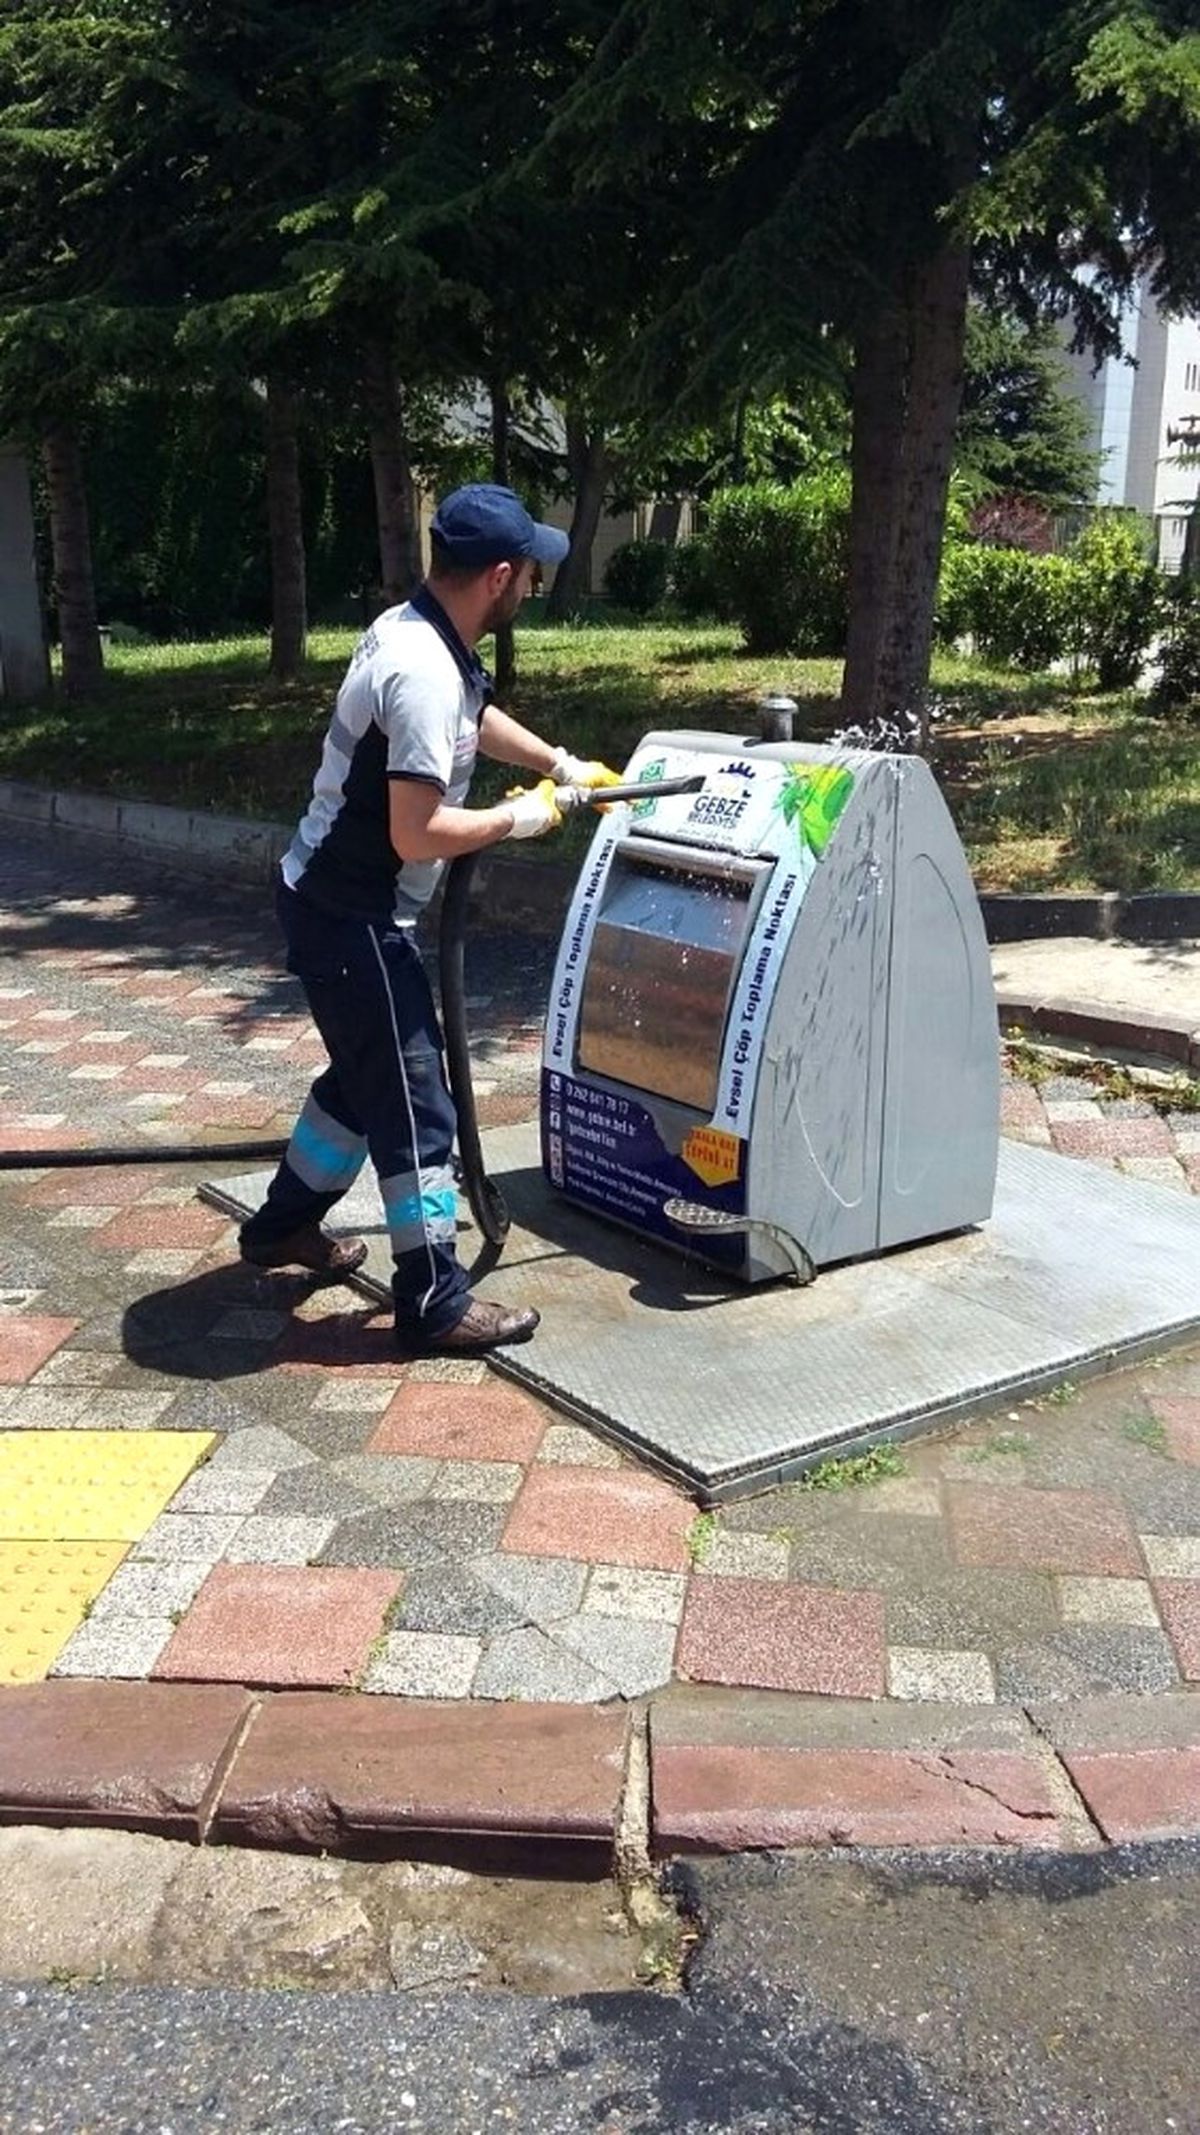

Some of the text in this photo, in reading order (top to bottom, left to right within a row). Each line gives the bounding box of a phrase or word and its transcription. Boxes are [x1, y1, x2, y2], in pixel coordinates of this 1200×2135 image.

[694, 795, 748, 819] GEBZE
[552, 837, 615, 1057] Evsel Çöp Toplama Noktası
[724, 873, 798, 1120] Evsel Çöp Toplama Noktası
